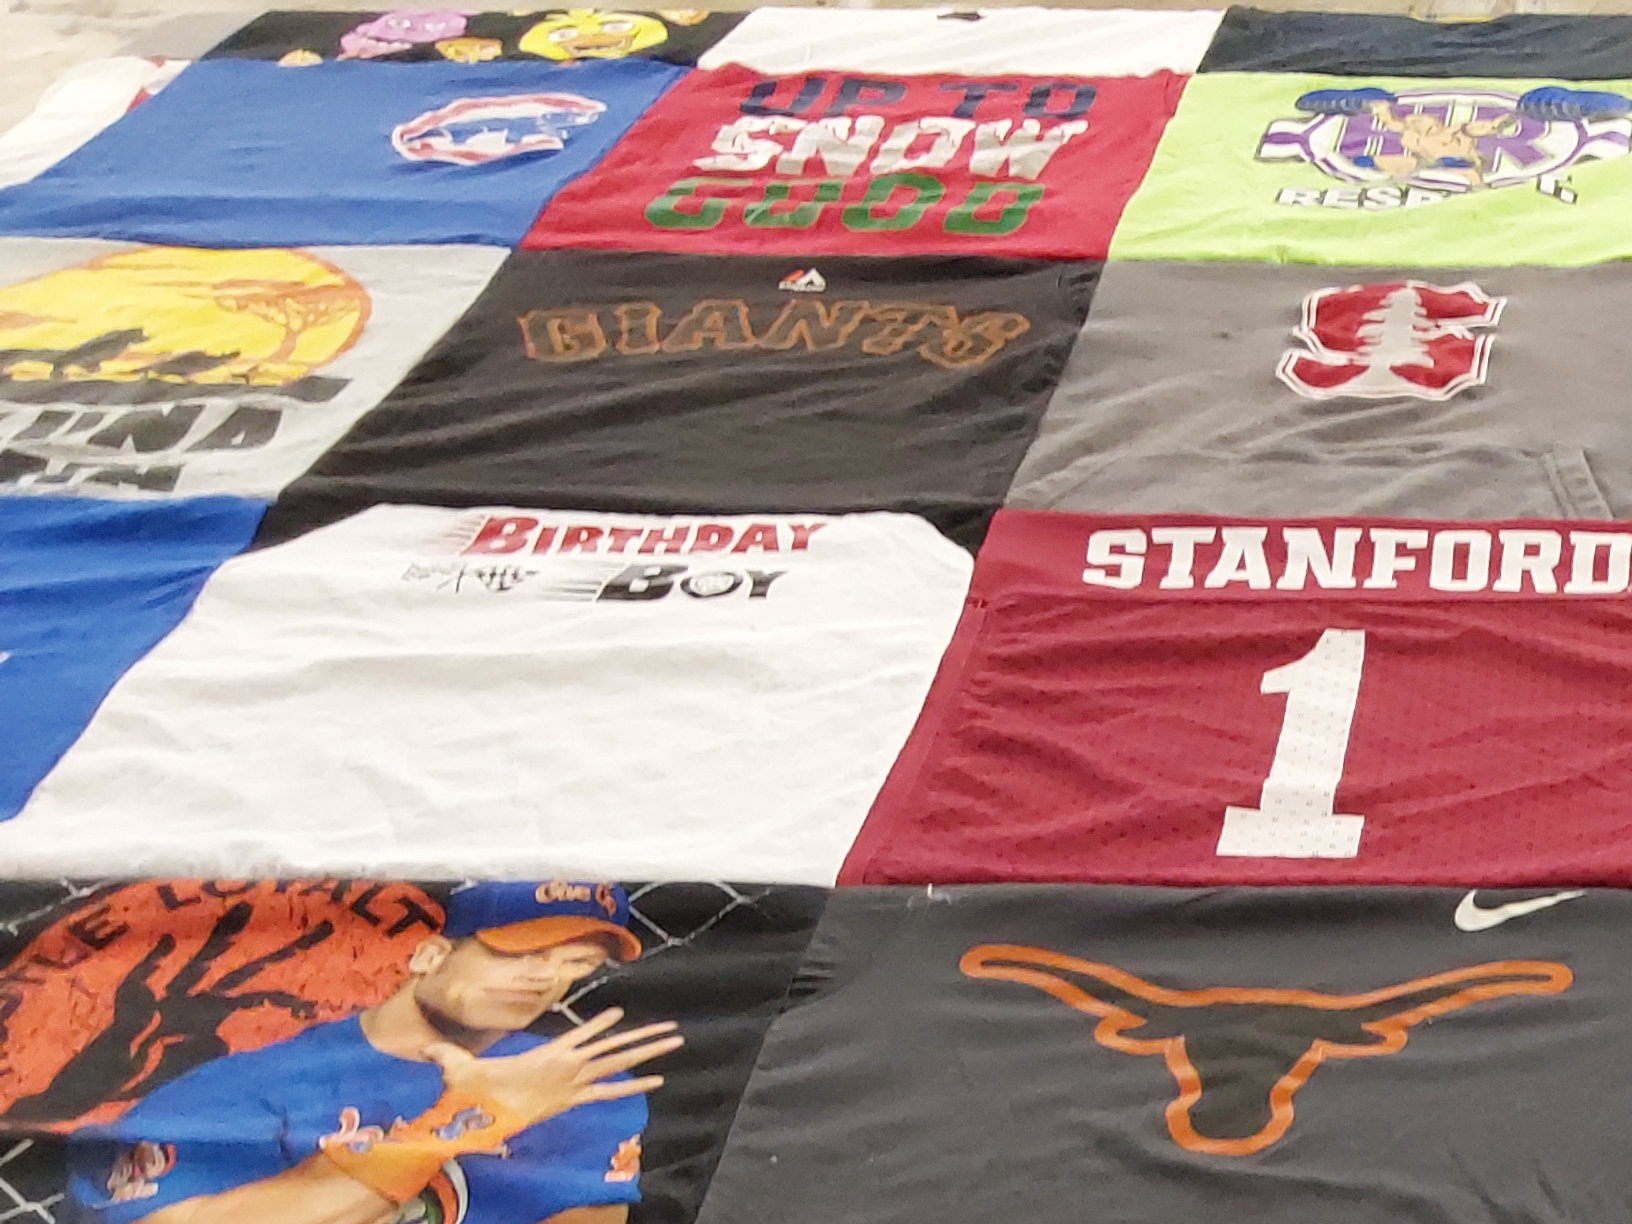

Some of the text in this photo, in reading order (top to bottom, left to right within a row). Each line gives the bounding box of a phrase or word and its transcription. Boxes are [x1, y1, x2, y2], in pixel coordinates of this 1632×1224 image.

[738, 77, 1097, 119] UP TO
[692, 115, 1089, 180] SNOW
[645, 172, 1046, 236] GOOD
[517, 297, 1031, 370] GIANTS
[460, 516, 827, 555] BIRTHDAY
[597, 562, 789, 602] BOY
[1215, 628, 1366, 859] 1
